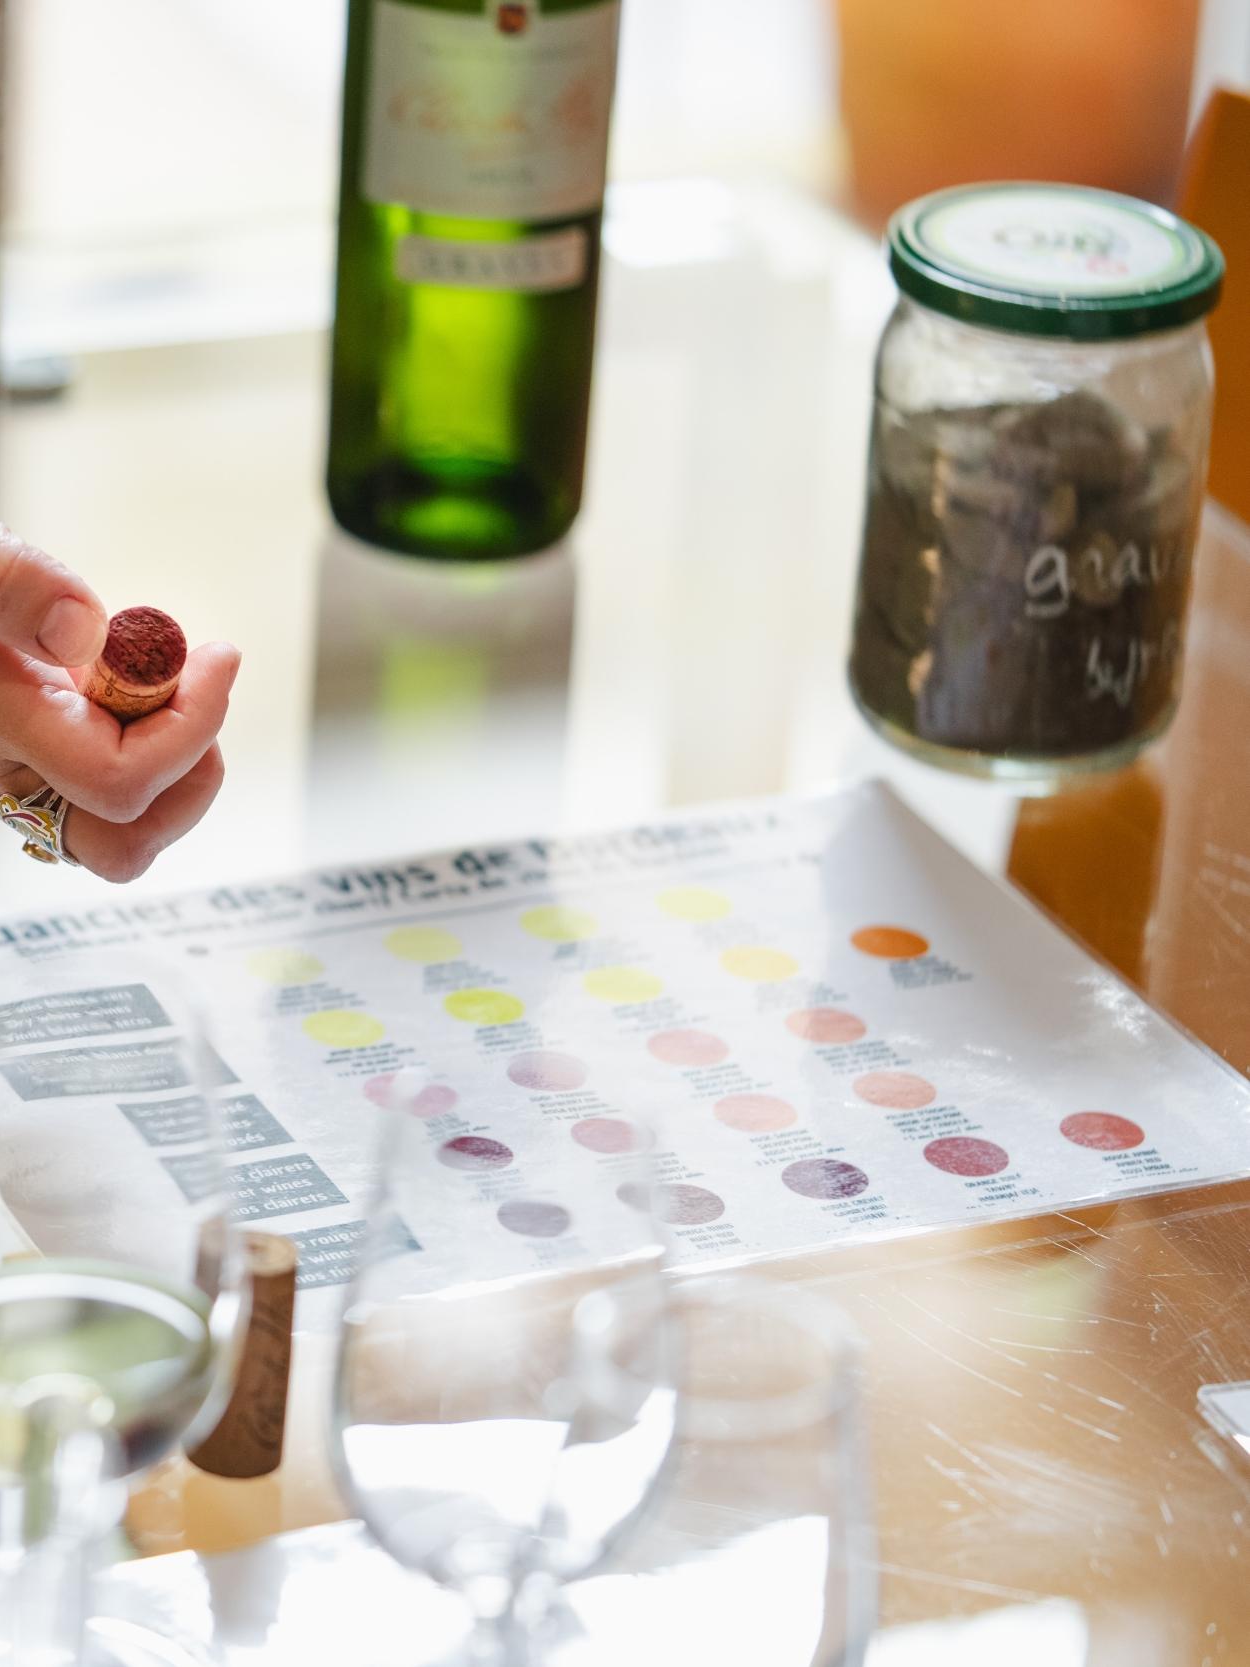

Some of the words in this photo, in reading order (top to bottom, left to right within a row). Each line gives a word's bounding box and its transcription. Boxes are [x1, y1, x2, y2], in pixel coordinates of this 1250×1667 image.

[209, 879, 306, 912] des
[317, 864, 437, 894] vins
[452, 849, 512, 876] de
[250, 1160, 316, 1182] clairets
[259, 1177, 314, 1195] wines
[264, 1192, 328, 1210] clairets
